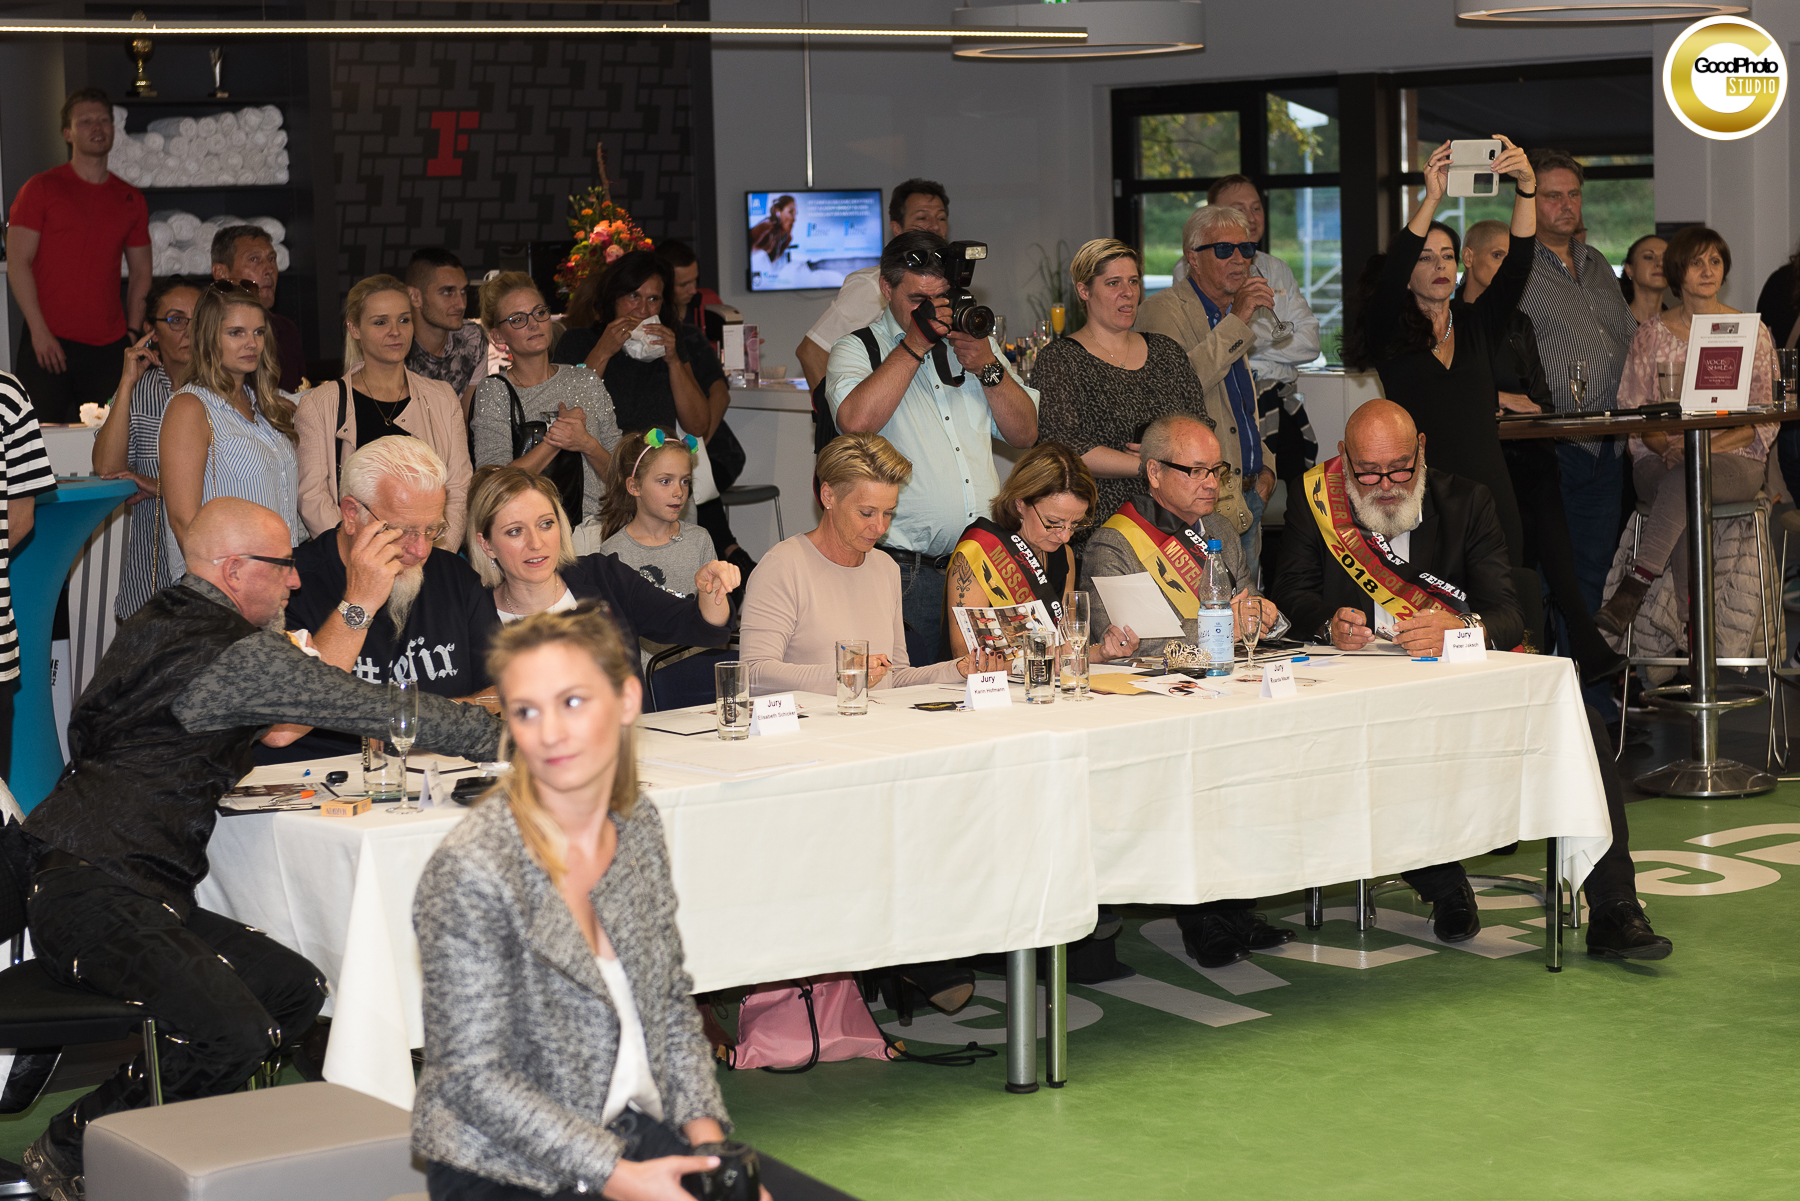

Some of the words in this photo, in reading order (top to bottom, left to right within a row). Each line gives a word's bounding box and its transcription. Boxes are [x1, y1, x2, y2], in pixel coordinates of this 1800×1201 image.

[1327, 473, 1348, 520] MISTER
[1010, 534, 1048, 586] GERMAN
[1331, 540, 1379, 594] 2018
[1418, 572, 1468, 602] GERMAN
[1457, 631, 1471, 639] Jury
[980, 675, 995, 683] Jury
[767, 699, 782, 708] Jury
